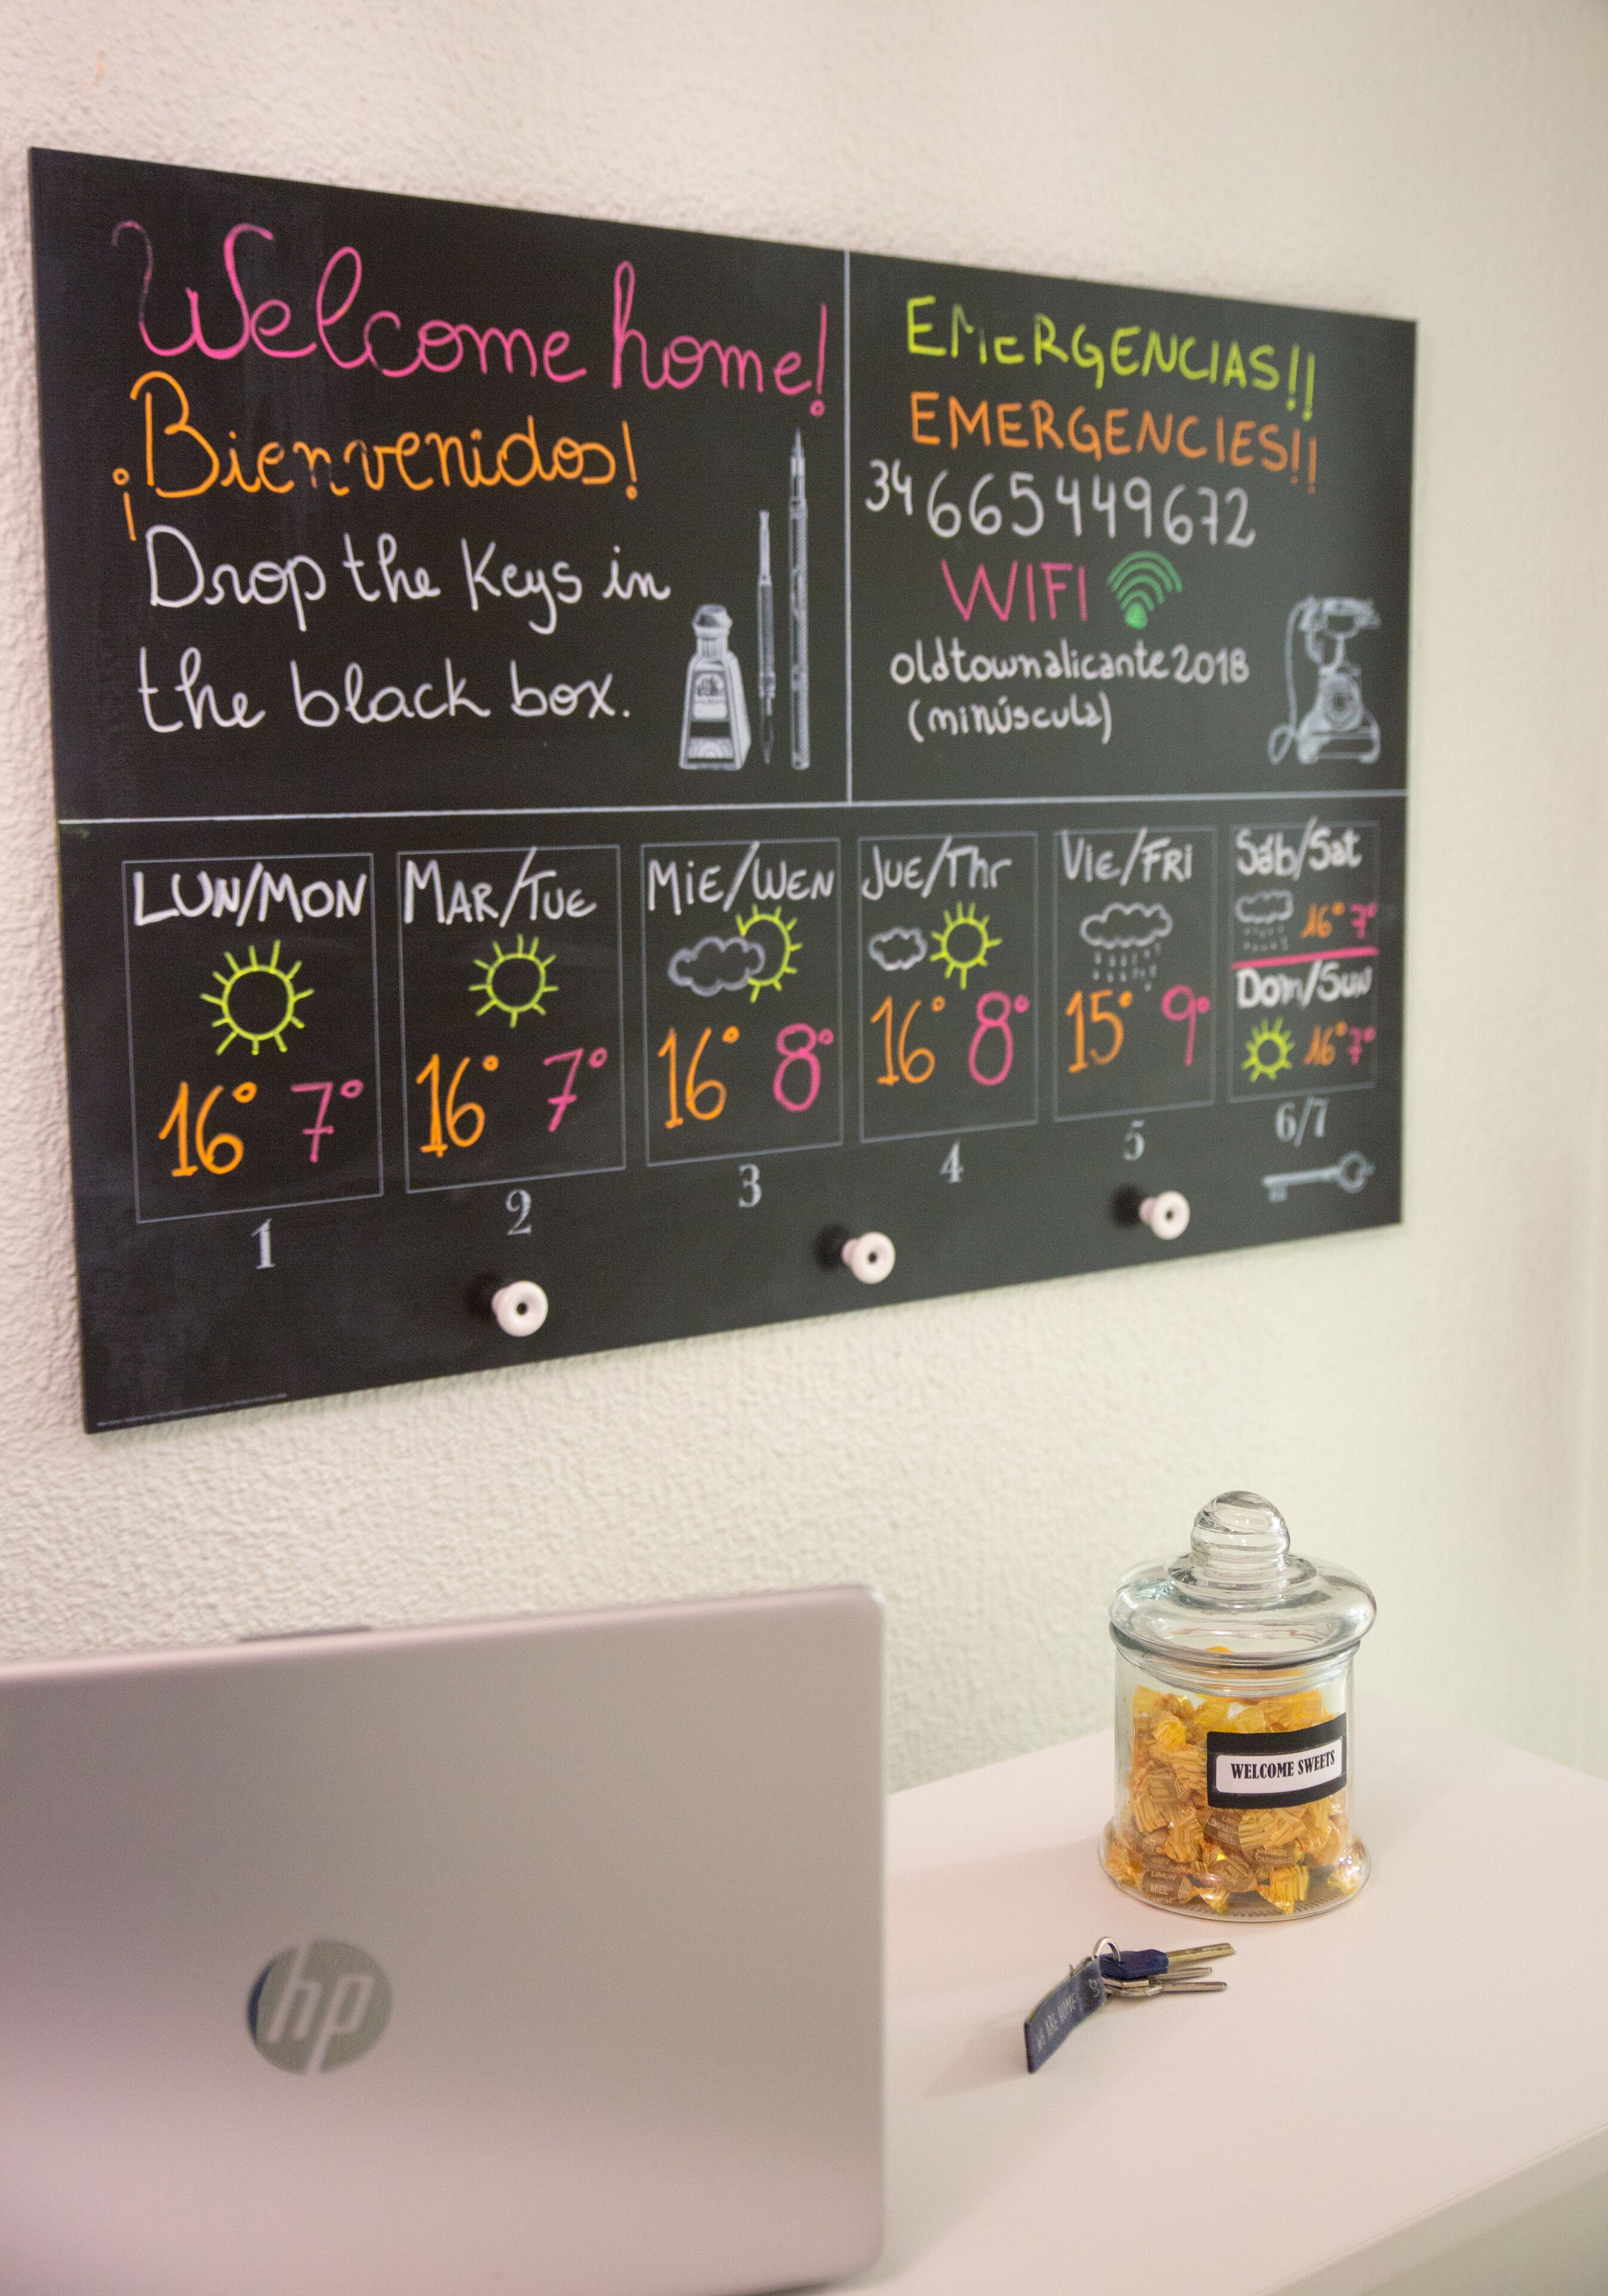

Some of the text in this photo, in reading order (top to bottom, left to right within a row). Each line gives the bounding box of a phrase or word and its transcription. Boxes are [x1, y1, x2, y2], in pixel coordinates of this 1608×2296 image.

[112, 220, 827, 417] Welcome home!
[112, 370, 638, 542] ¡Bienvenidos!
[911, 391, 1317, 494] EMERGENCIES!!
[866, 459, 913, 516] 34
[146, 525, 326, 631] Drop
[341, 532, 441, 602] the
[602, 545, 671, 600] in
[941, 558, 1088, 622] WIFI
[139, 646, 630, 733] the black box.
[889, 636, 1250, 685] oldtownalicante2018
[134, 863, 367, 927] LUN/MON
[871, 991, 1030, 1086] 16° 8°
[1065, 984, 1210, 1073] 15° 9°
[417, 1048, 608, 1157] 16° 7°
[658, 1023, 834, 1129] 16° 8°
[160, 1079, 363, 1177] 16° 7°
[940, 1138, 964, 1183] 4
[1124, 1119, 1145, 1161] 5
[1275, 1097, 1329, 1149] 6/7
[506, 1189, 532, 1236] 2
[738, 1163, 763, 1208] 3
[252, 1219, 275, 1270] 1
[1231, 1750, 1335, 1779] WELCOME SWEETS
[263, 1940, 377, 2074] hp
